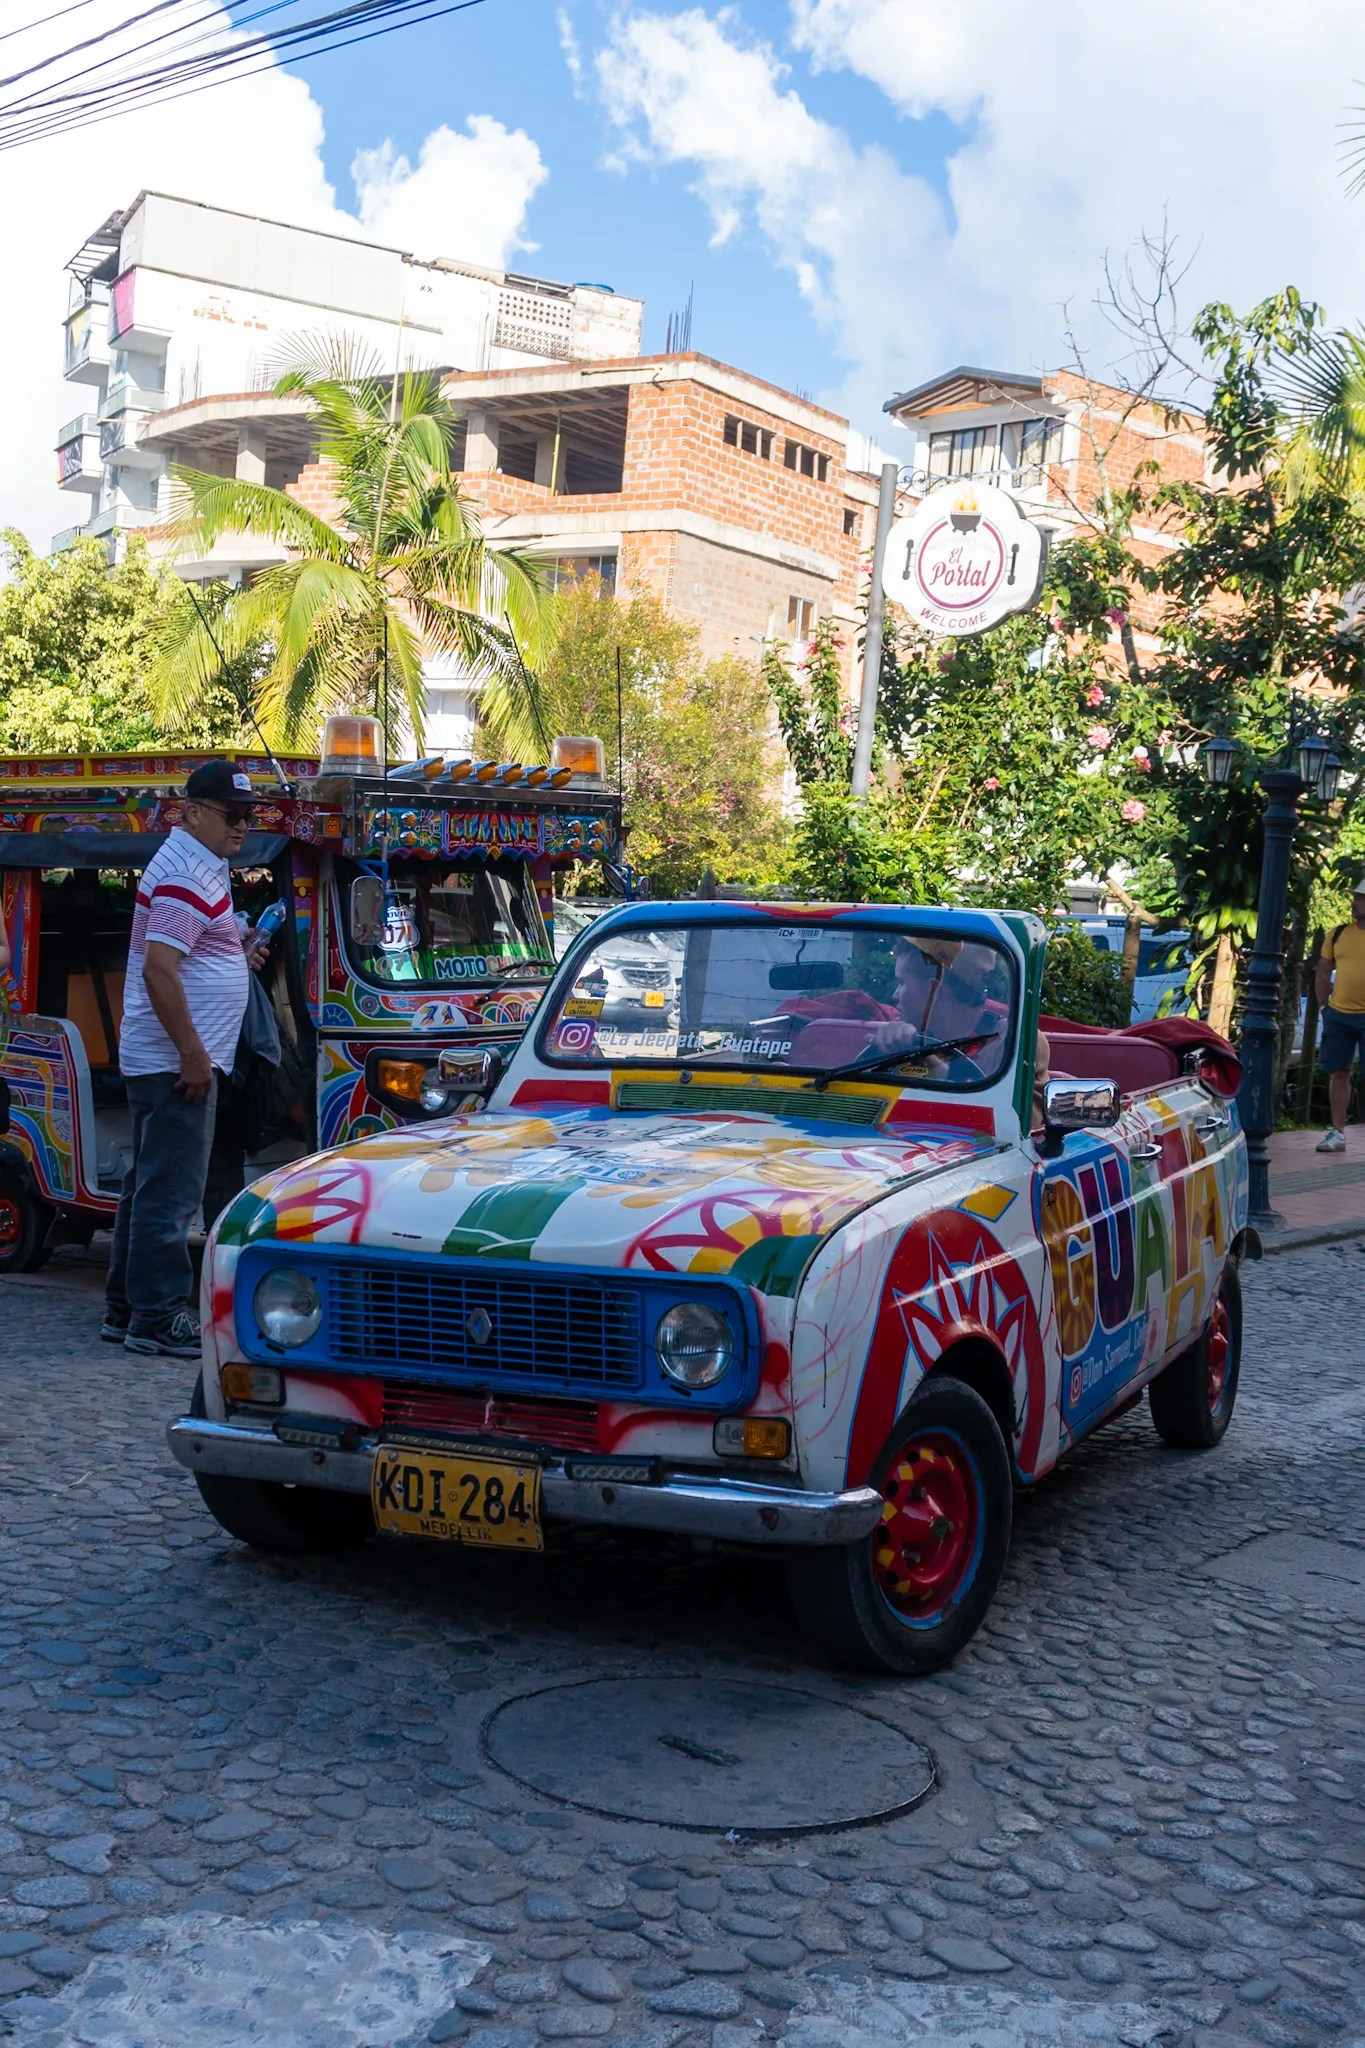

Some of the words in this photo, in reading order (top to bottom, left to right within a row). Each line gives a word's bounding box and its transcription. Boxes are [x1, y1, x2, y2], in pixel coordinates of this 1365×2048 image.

[948, 546, 964, 565] El
[929, 559, 992, 587] Portal
[920, 607, 988, 628] WELCOME
[450, 813, 539, 842] GUATAPE
[458, 1473, 531, 1528] 284
